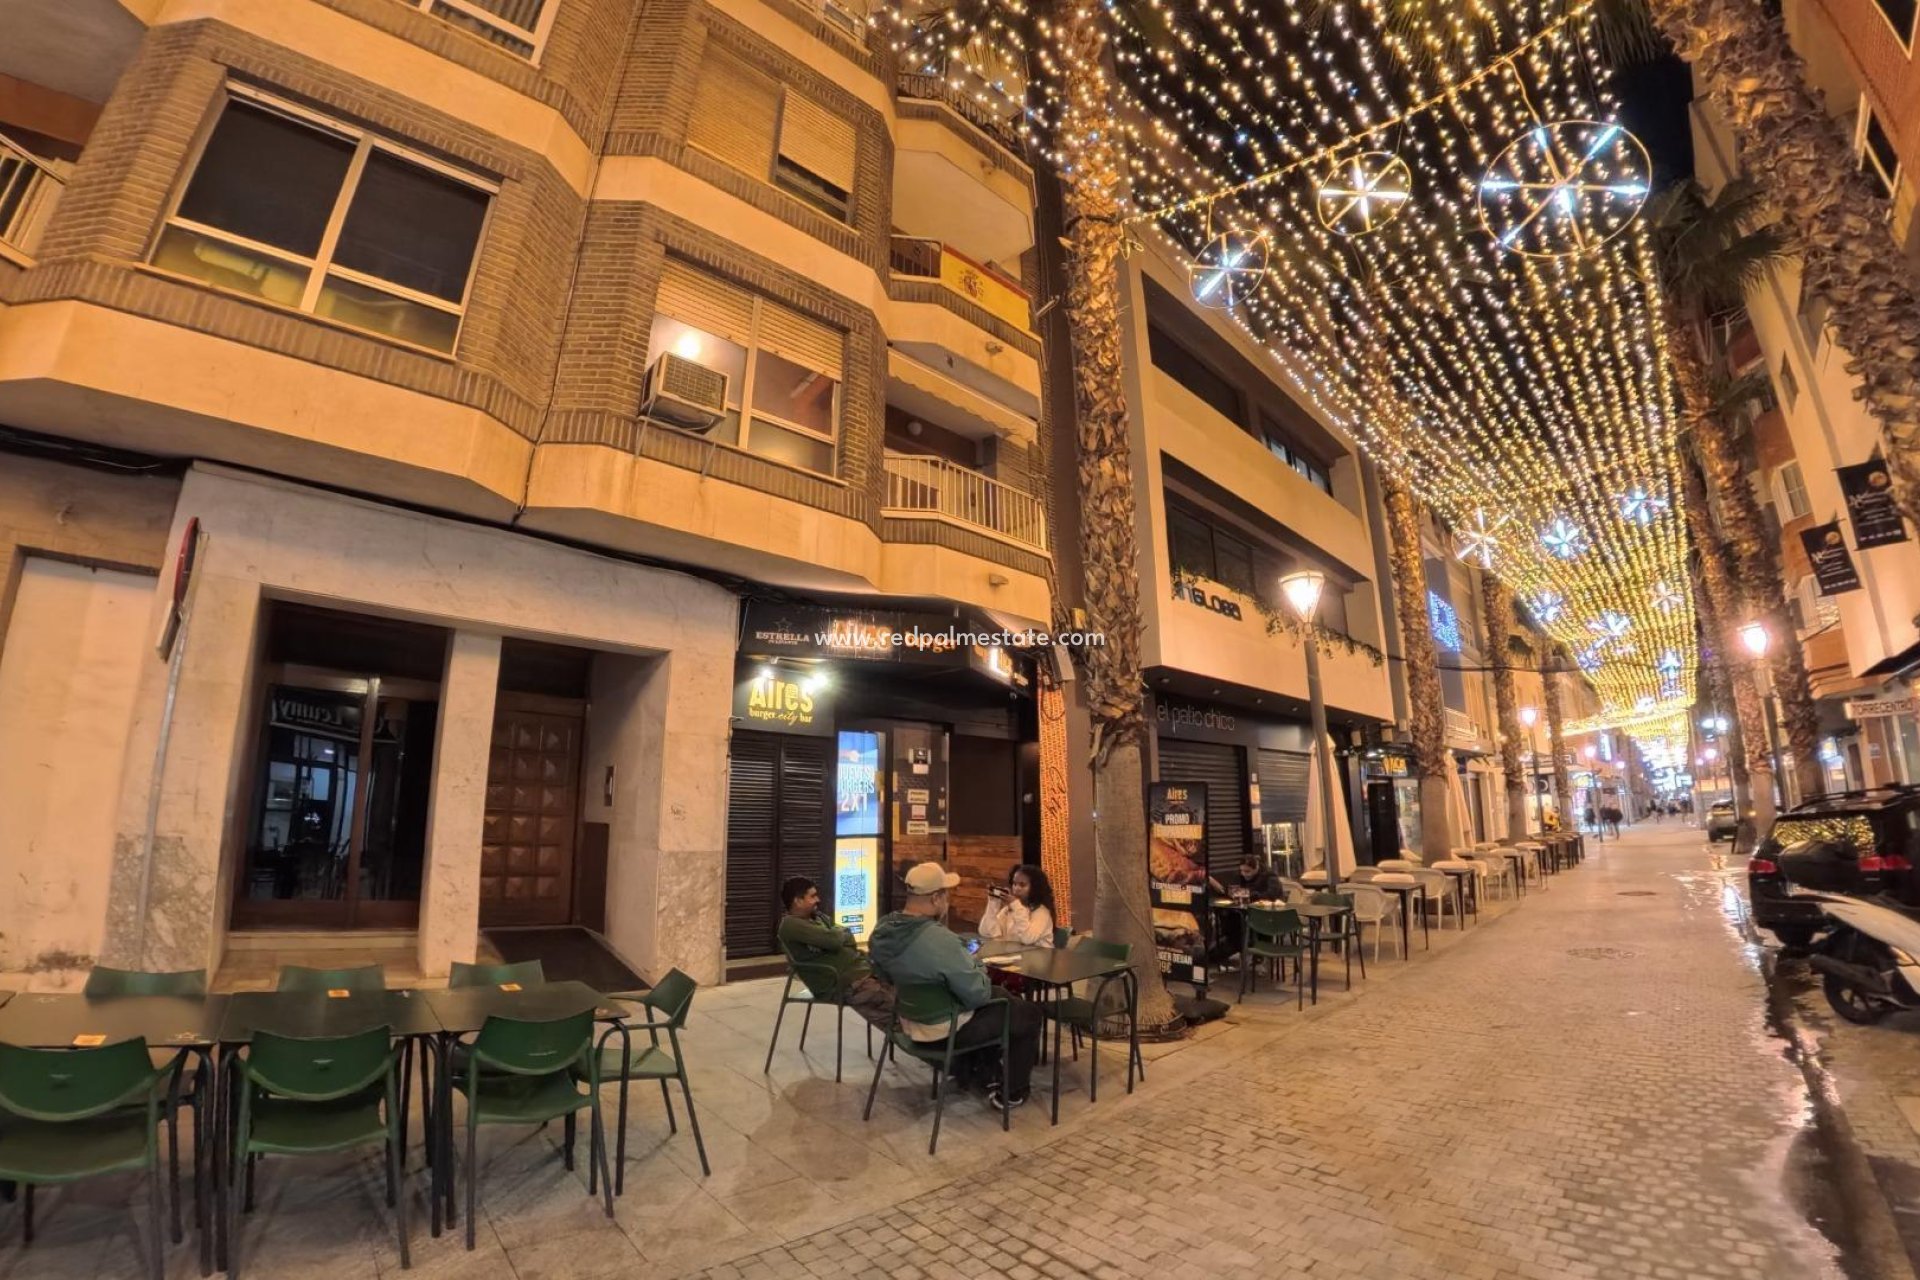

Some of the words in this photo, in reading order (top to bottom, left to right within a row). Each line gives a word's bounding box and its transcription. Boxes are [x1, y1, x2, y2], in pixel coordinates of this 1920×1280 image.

[755, 631, 809, 642] ESTRELLA
[749, 677, 813, 713] Aires
[748, 707, 776, 720] burger
[799, 712, 813, 723] bar
[1157, 700, 1169, 721] el
[1172, 705, 1203, 734] patio
[1205, 708, 1235, 731] chico
[1167, 786, 1188, 800] Aires
[1164, 813, 1190, 825] PROMO
